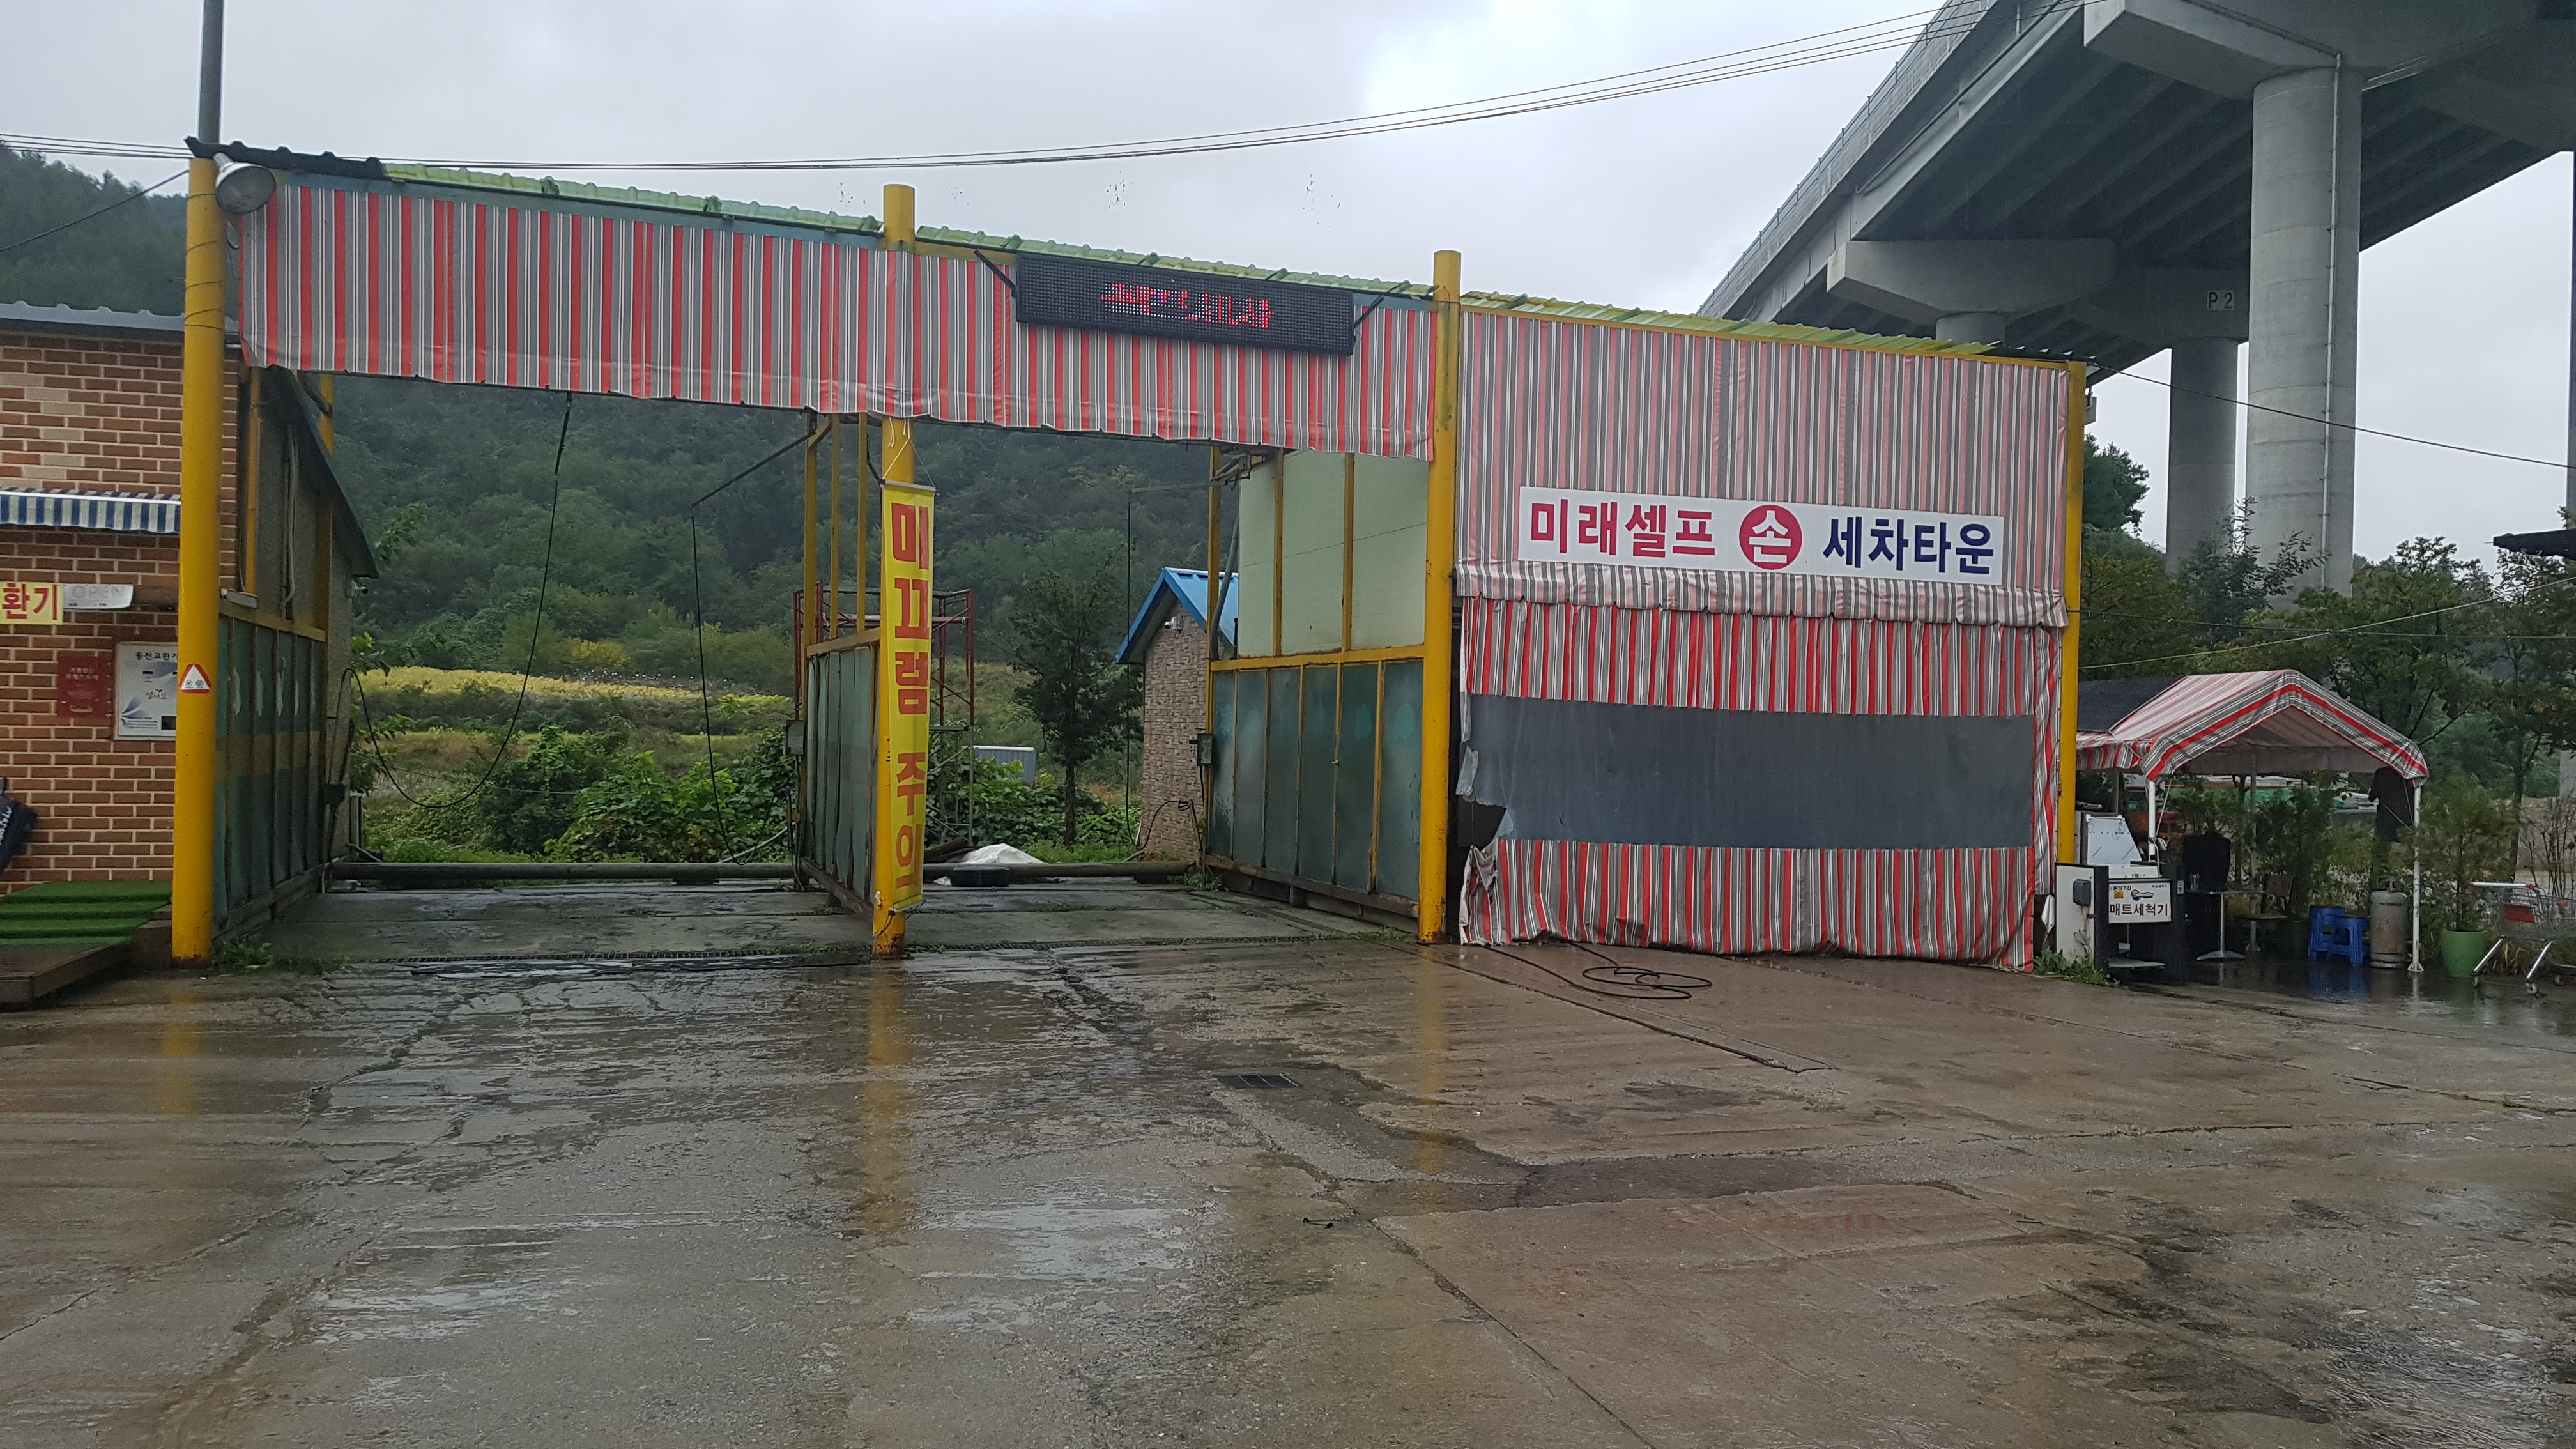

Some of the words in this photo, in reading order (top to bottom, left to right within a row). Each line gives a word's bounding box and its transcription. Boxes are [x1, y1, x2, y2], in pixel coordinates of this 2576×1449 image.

[1531, 498, 1716, 558] 미래셀프
[1748, 509, 1790, 564] 손
[1823, 516, 1995, 575] 세차타운
[1, 582, 59, 621] 환기
[891, 502, 930, 716] 미끄럼
[895, 751, 926, 889] 주의
[2110, 903, 2168, 916] 매트세척기
